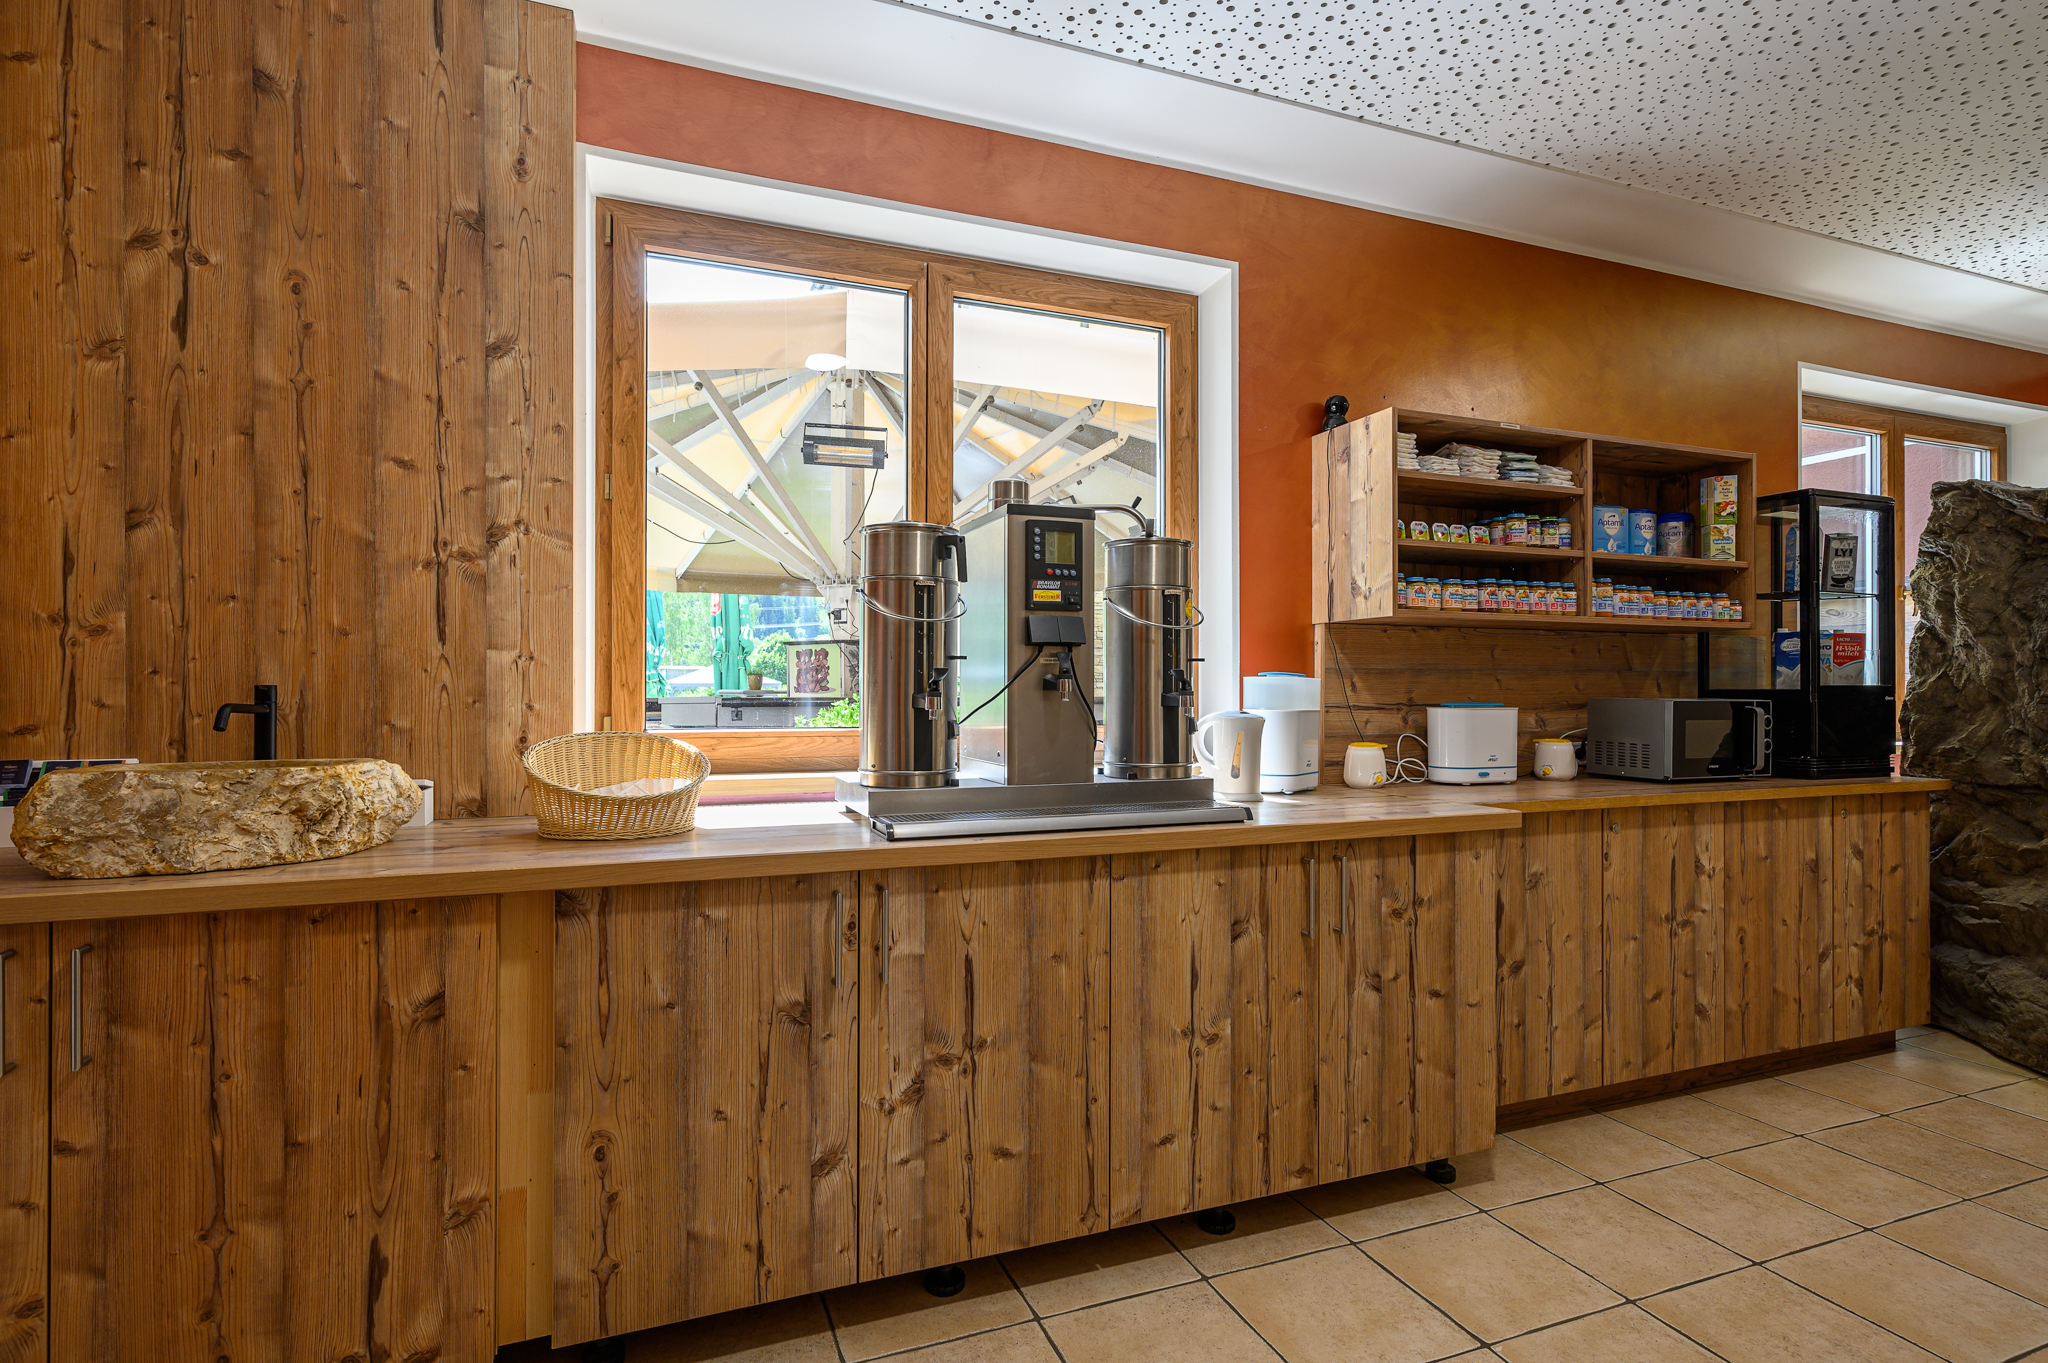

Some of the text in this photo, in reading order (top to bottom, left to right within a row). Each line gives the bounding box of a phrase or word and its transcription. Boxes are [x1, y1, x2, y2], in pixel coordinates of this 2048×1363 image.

[1598, 518, 1624, 527] Aptamil
[1658, 530, 1686, 538] Aptamil
[1834, 548, 1852, 556] LY!
